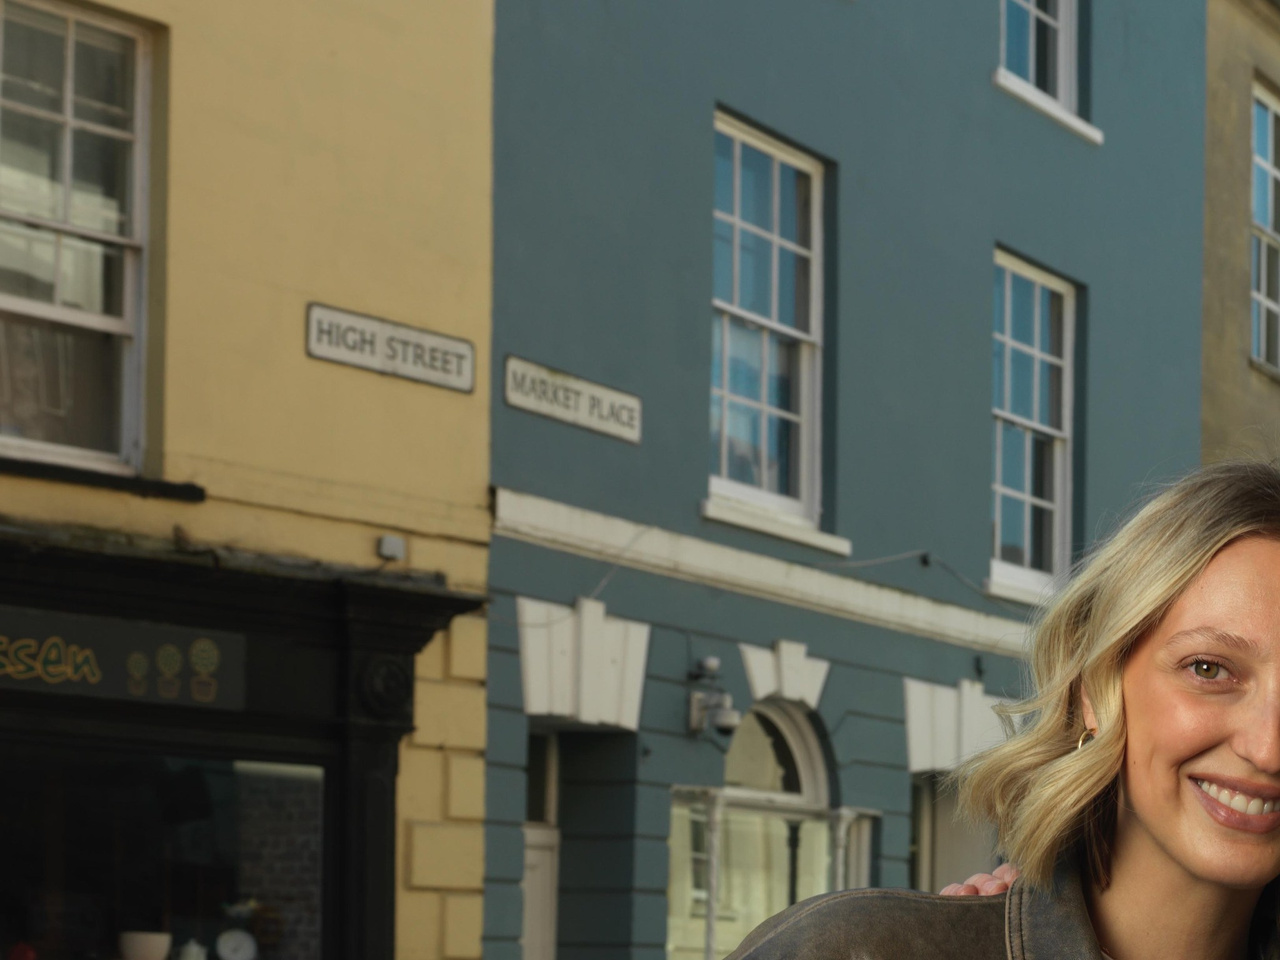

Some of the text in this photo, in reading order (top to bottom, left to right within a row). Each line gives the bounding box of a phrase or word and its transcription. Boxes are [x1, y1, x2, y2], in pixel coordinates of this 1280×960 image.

[315, 319, 467, 377] HIGH STREET
[510, 370, 637, 430] MARKET PLACE
